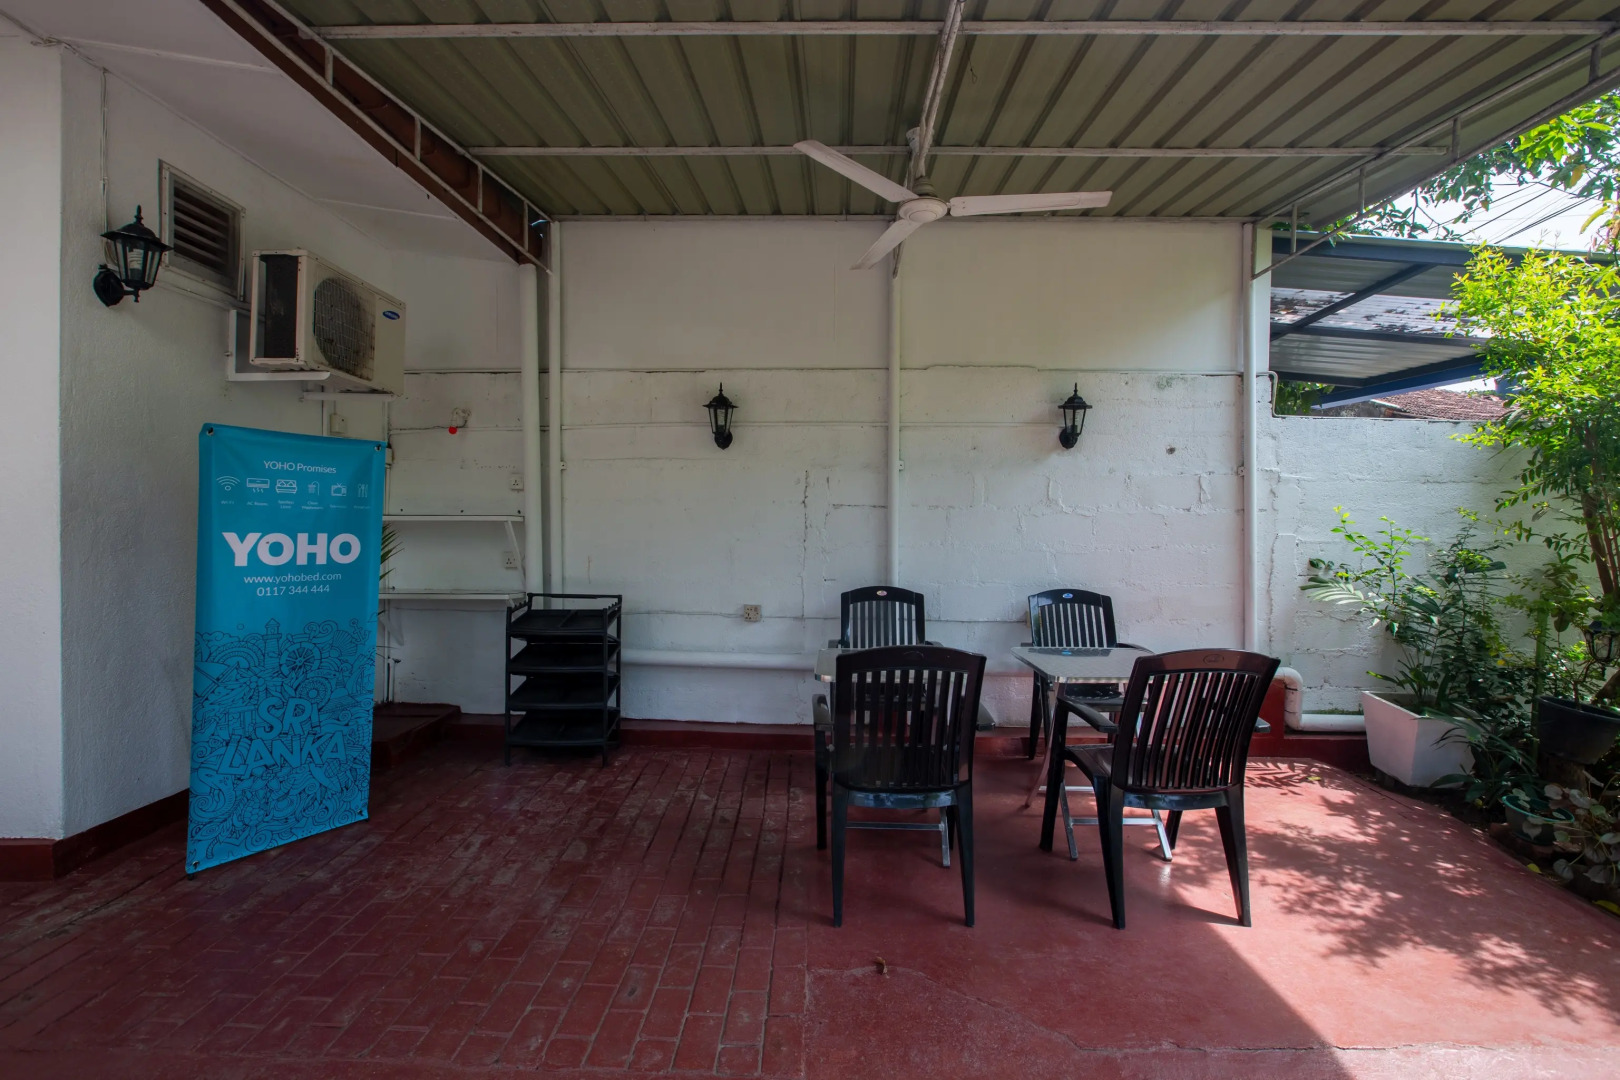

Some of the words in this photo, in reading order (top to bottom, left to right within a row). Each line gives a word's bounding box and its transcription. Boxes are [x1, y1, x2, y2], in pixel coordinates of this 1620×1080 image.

[264, 460, 295, 470] YOHO
[297, 463, 337, 474] Promises
[221, 532, 361, 567] YOHO
[243, 572, 342, 584] www.yohobed.com
[256, 587, 286, 596] 0117
[289, 585, 308, 595] 344
[310, 584, 330, 593] 444
[255, 696, 320, 740] SRI
[216, 729, 347, 775] LANKA
